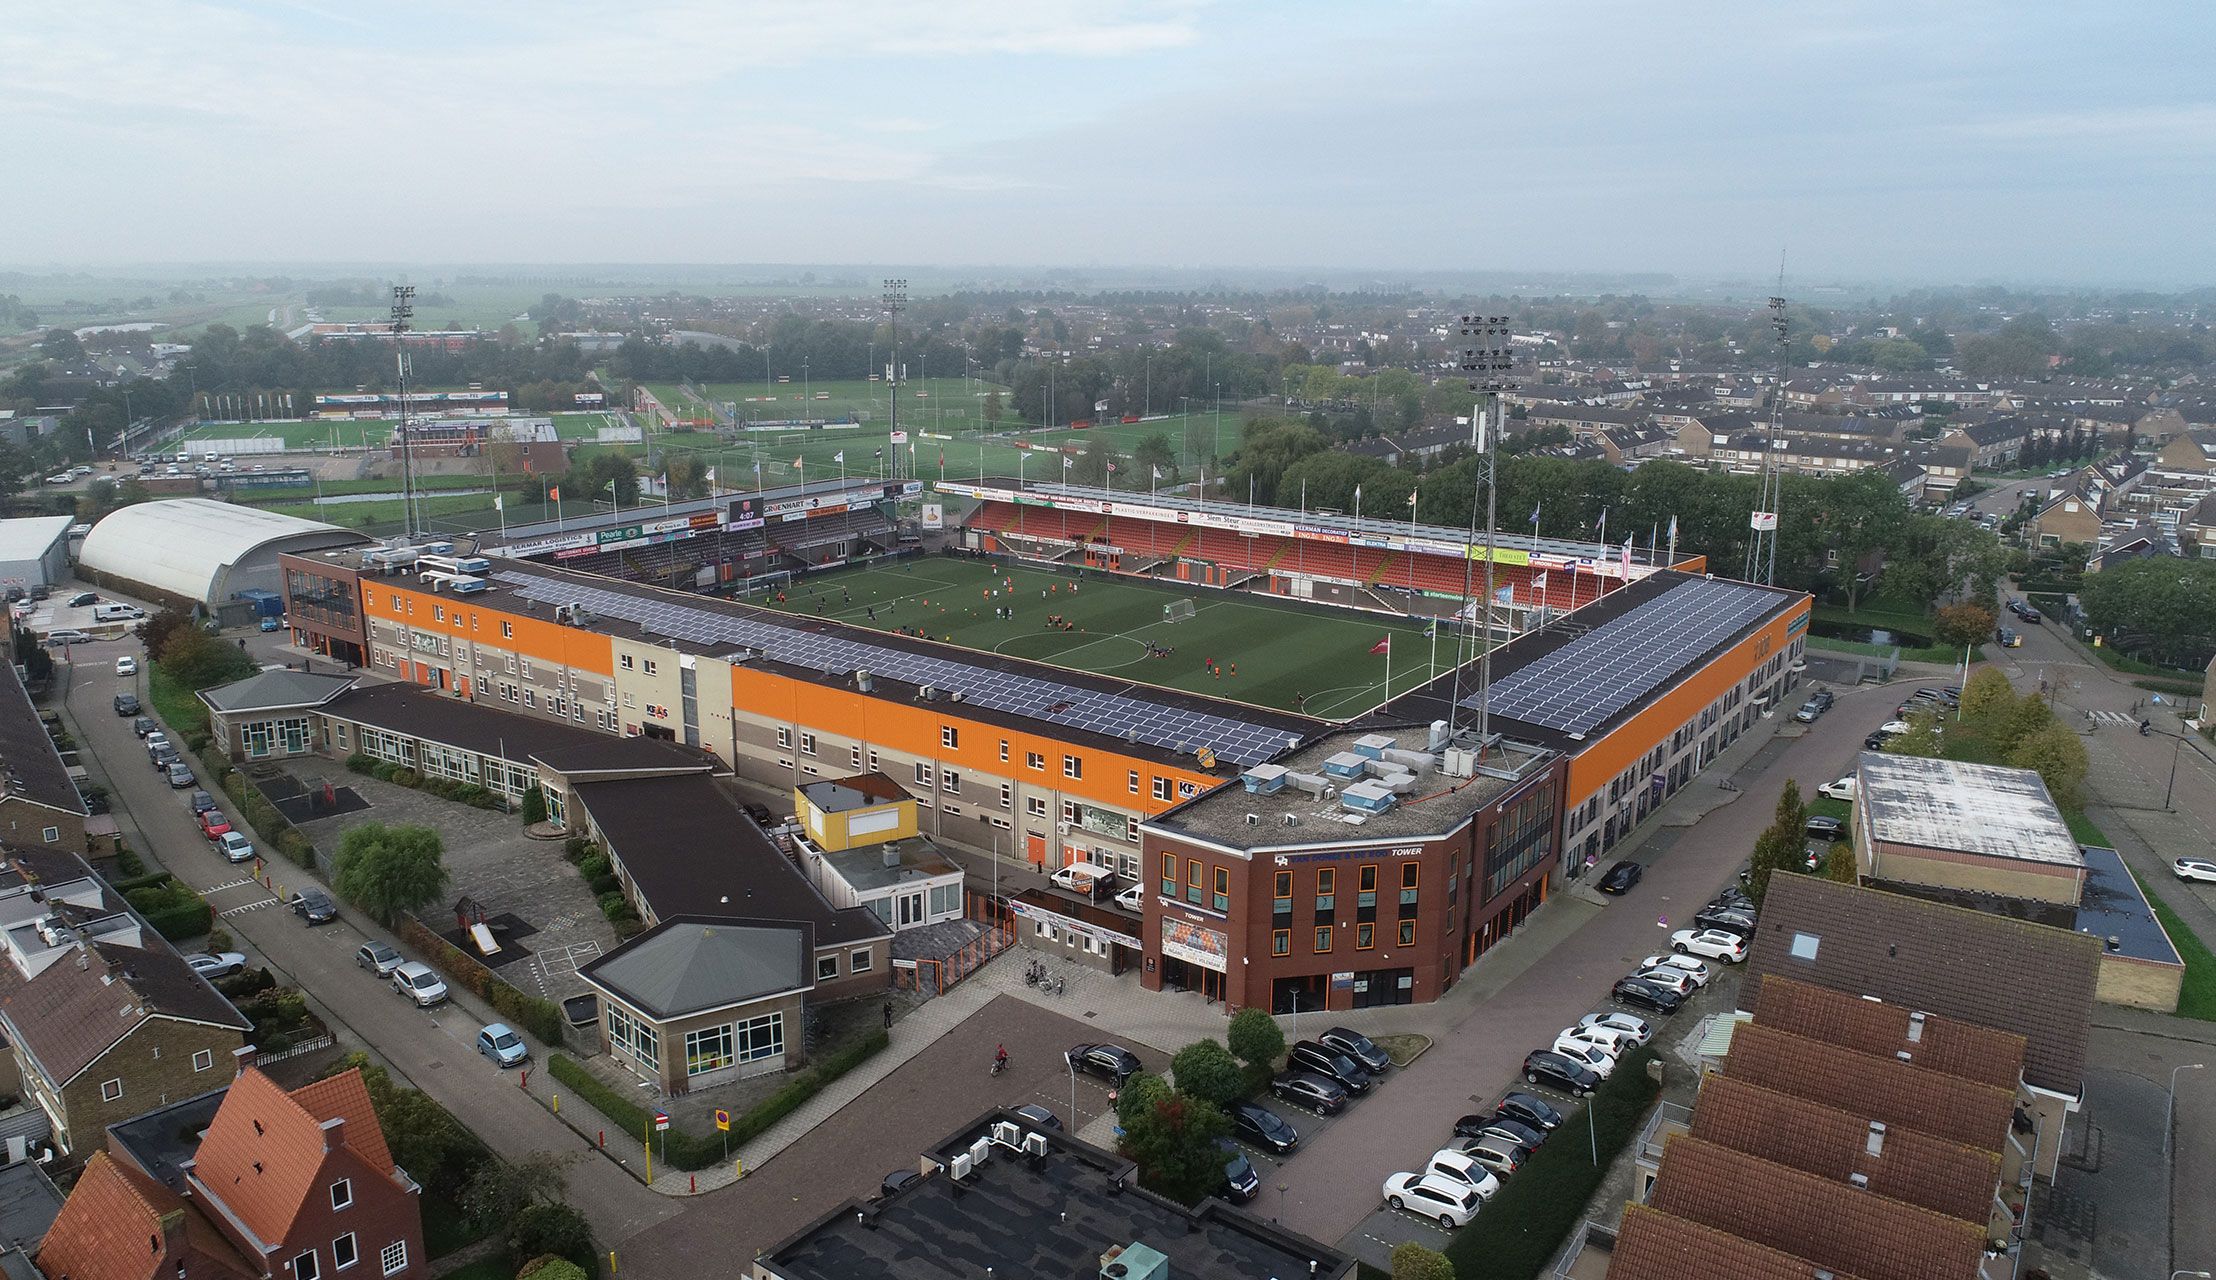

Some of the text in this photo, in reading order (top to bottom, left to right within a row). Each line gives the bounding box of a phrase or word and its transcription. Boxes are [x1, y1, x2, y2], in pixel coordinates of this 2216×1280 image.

[764, 500, 805, 513] GROENHART
[739, 511, 755, 520] 4:07
[600, 530, 622, 540] Pearle
[511, 534, 583, 550] SERMAR LOGISTICS
[1391, 847, 1423, 857] TOWER
[1184, 912, 1205, 922] TOWER
